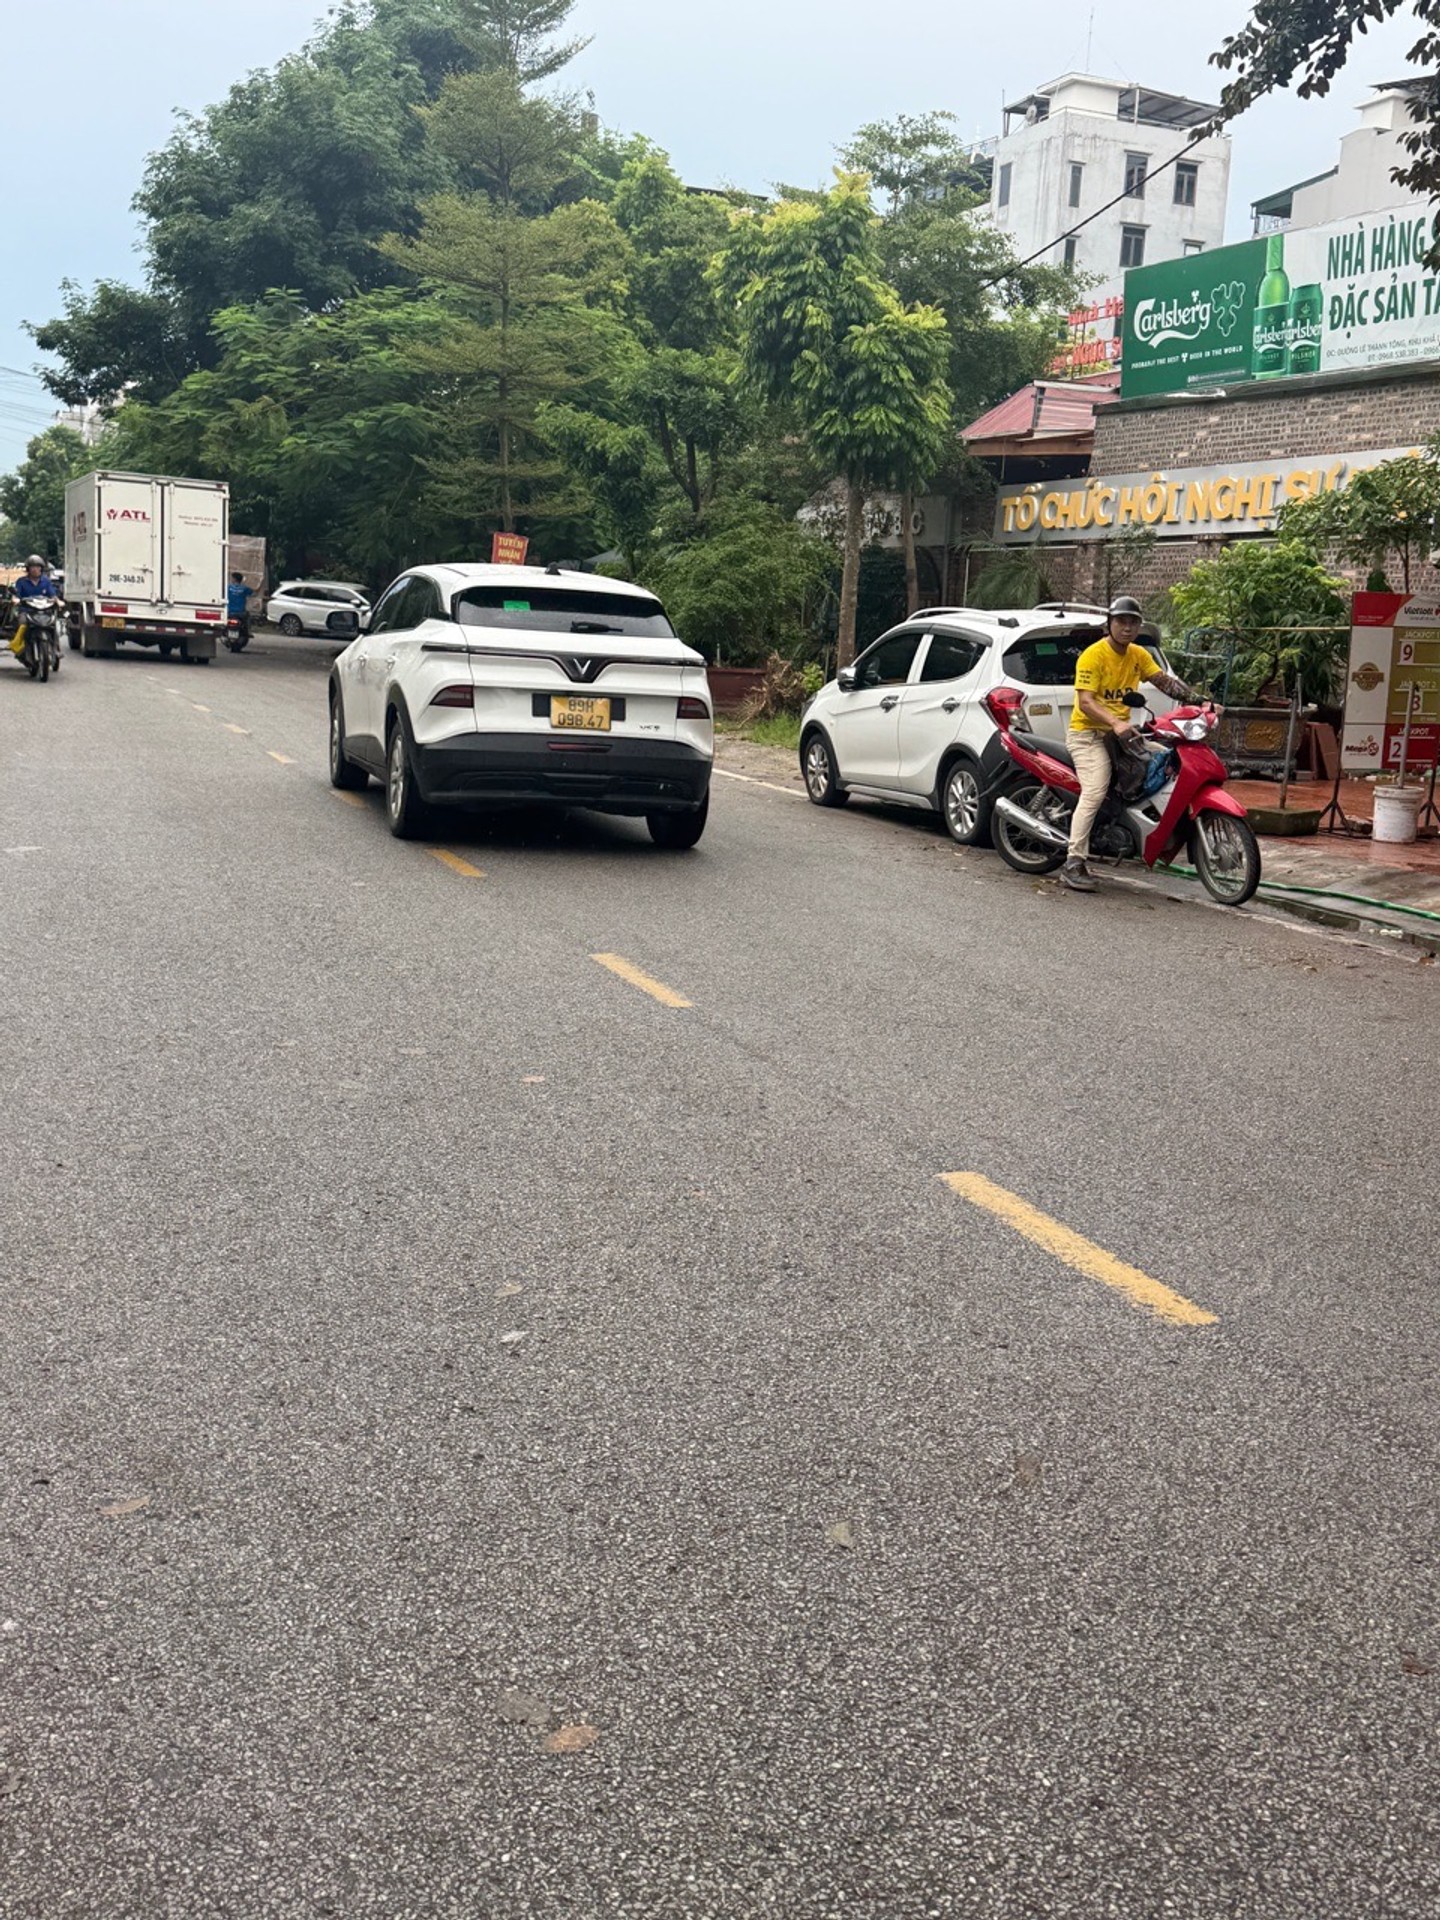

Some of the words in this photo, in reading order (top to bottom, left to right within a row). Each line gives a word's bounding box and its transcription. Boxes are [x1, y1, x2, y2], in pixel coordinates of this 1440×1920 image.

[1327, 221, 1365, 281] NHÀ
[1370, 214, 1426, 273] HÀNG
[1329, 283, 1369, 340] ĐẶC
[1372, 272, 1416, 324] SẢN
[1134, 298, 1211, 347] Carlsberg
[1001, 483, 1042, 533] TỔ
[1040, 477, 1117, 530] CHỨC
[1186, 472, 1281, 529] NGHỊ
[120, 509, 151, 520] ATL
[1404, 606, 1433, 615] Vietlott
[1403, 644, 1413, 661] 9
[568, 699, 594, 713] 89H
[1392, 741, 1402, 759] 2
